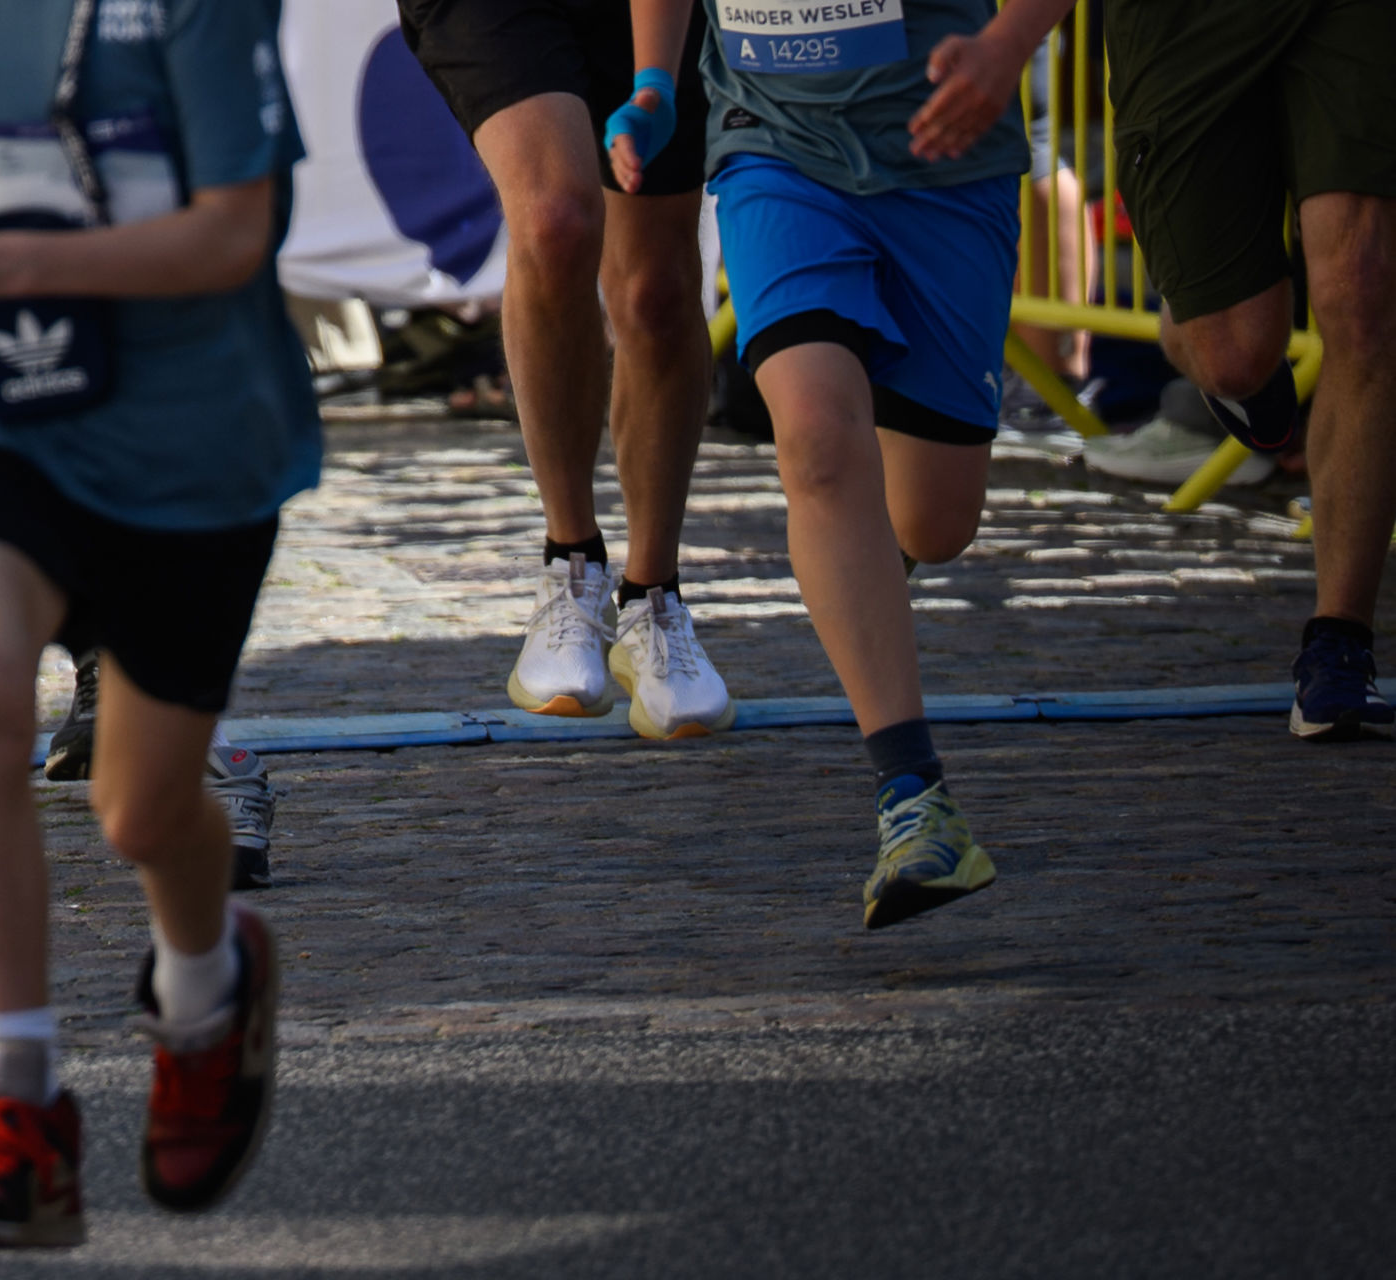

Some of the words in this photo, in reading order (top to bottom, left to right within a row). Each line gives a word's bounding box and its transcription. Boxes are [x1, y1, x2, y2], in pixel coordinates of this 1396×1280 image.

[725, 6, 793, 25] SANDER
[740, 38, 756, 59] A
[768, 37, 840, 62] 14295
